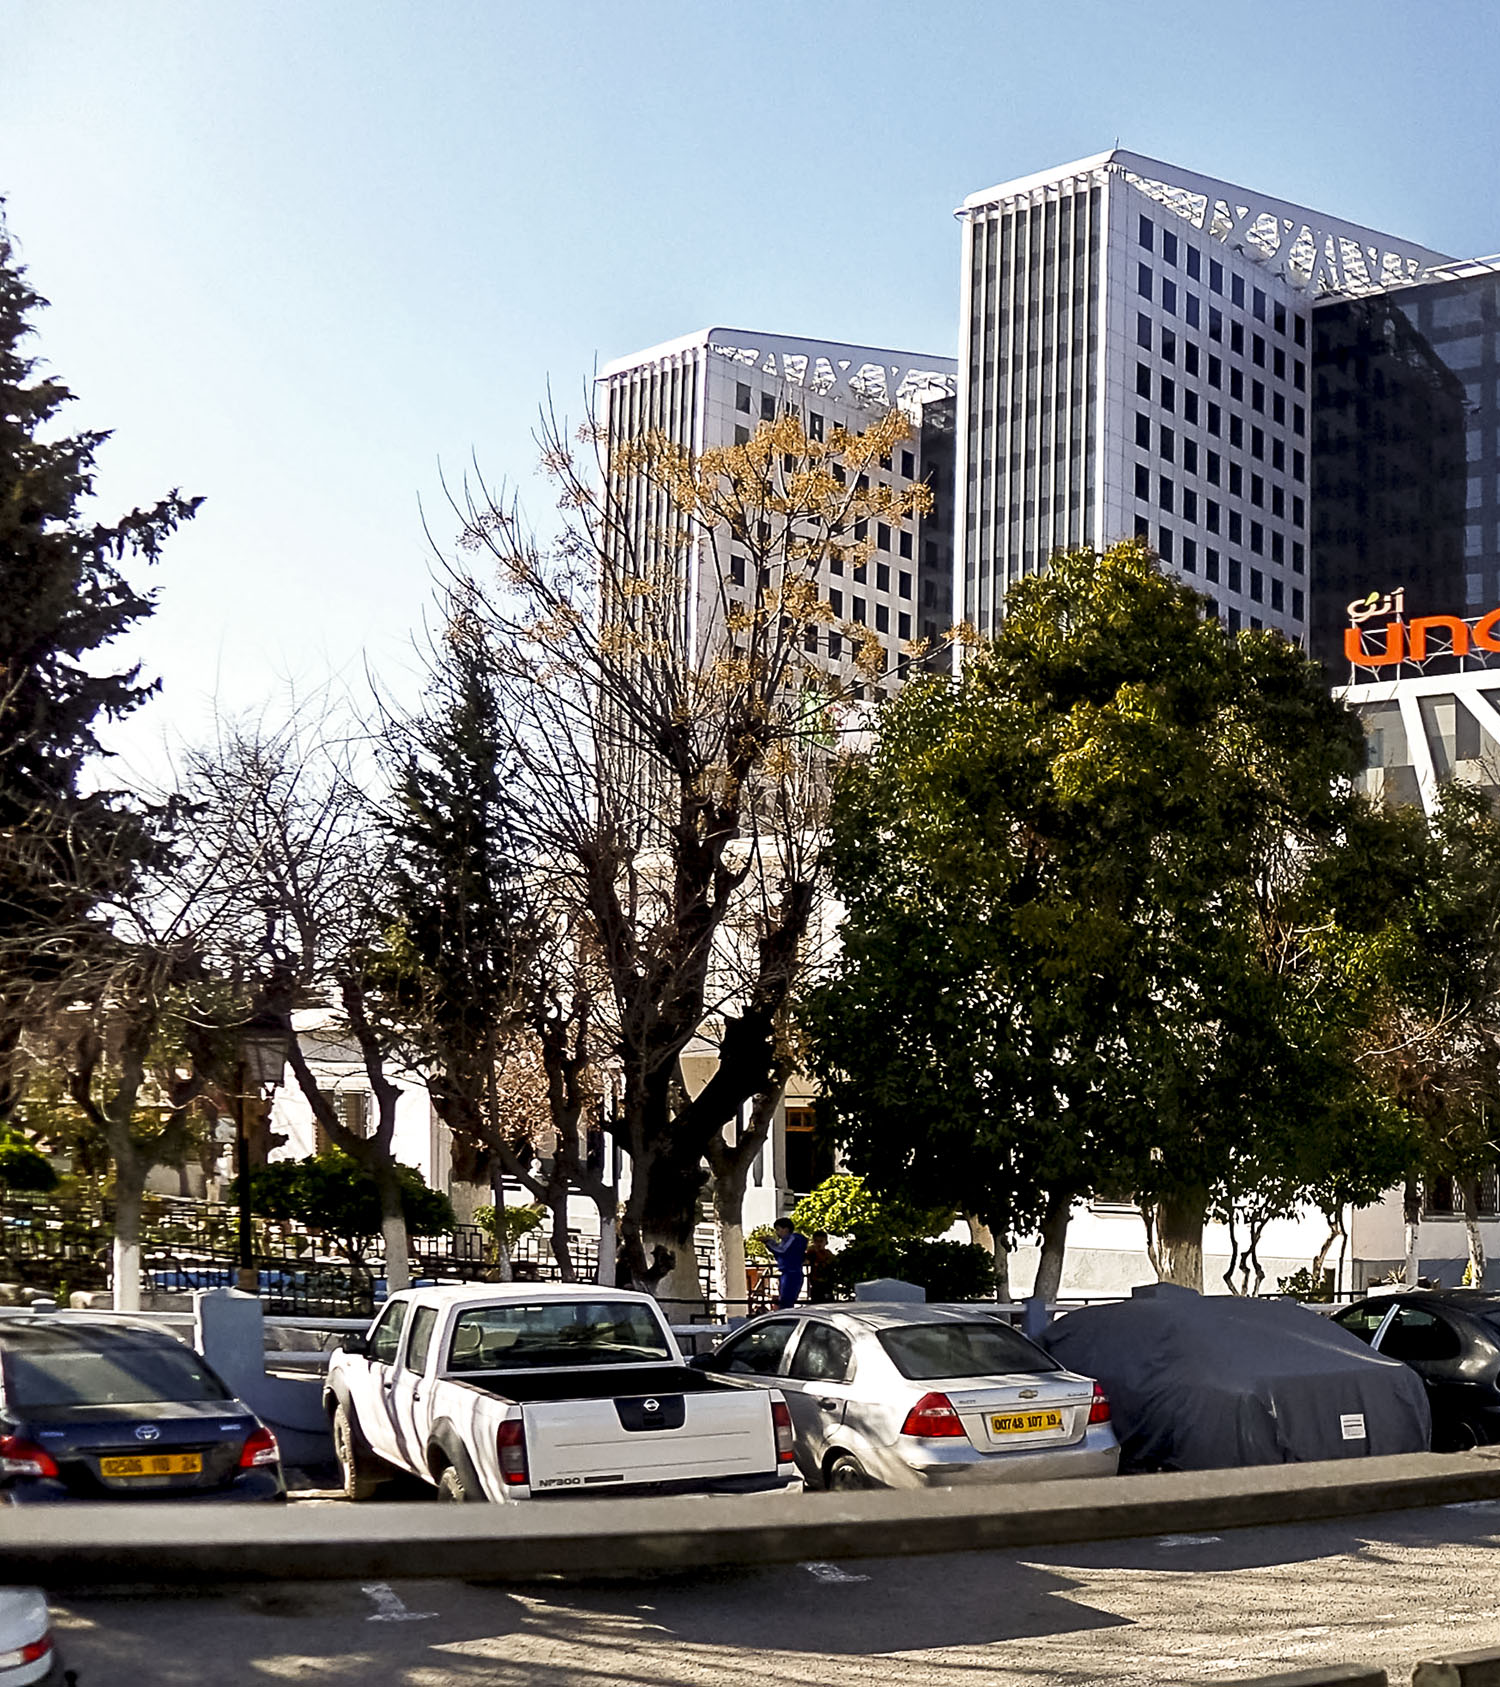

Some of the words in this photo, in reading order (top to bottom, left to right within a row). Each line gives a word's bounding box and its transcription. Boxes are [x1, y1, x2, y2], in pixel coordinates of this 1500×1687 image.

[994, 1416, 1024, 1431] 00748
[1027, 1415, 1043, 1427] 107
[1046, 1413, 1056, 1426] 19
